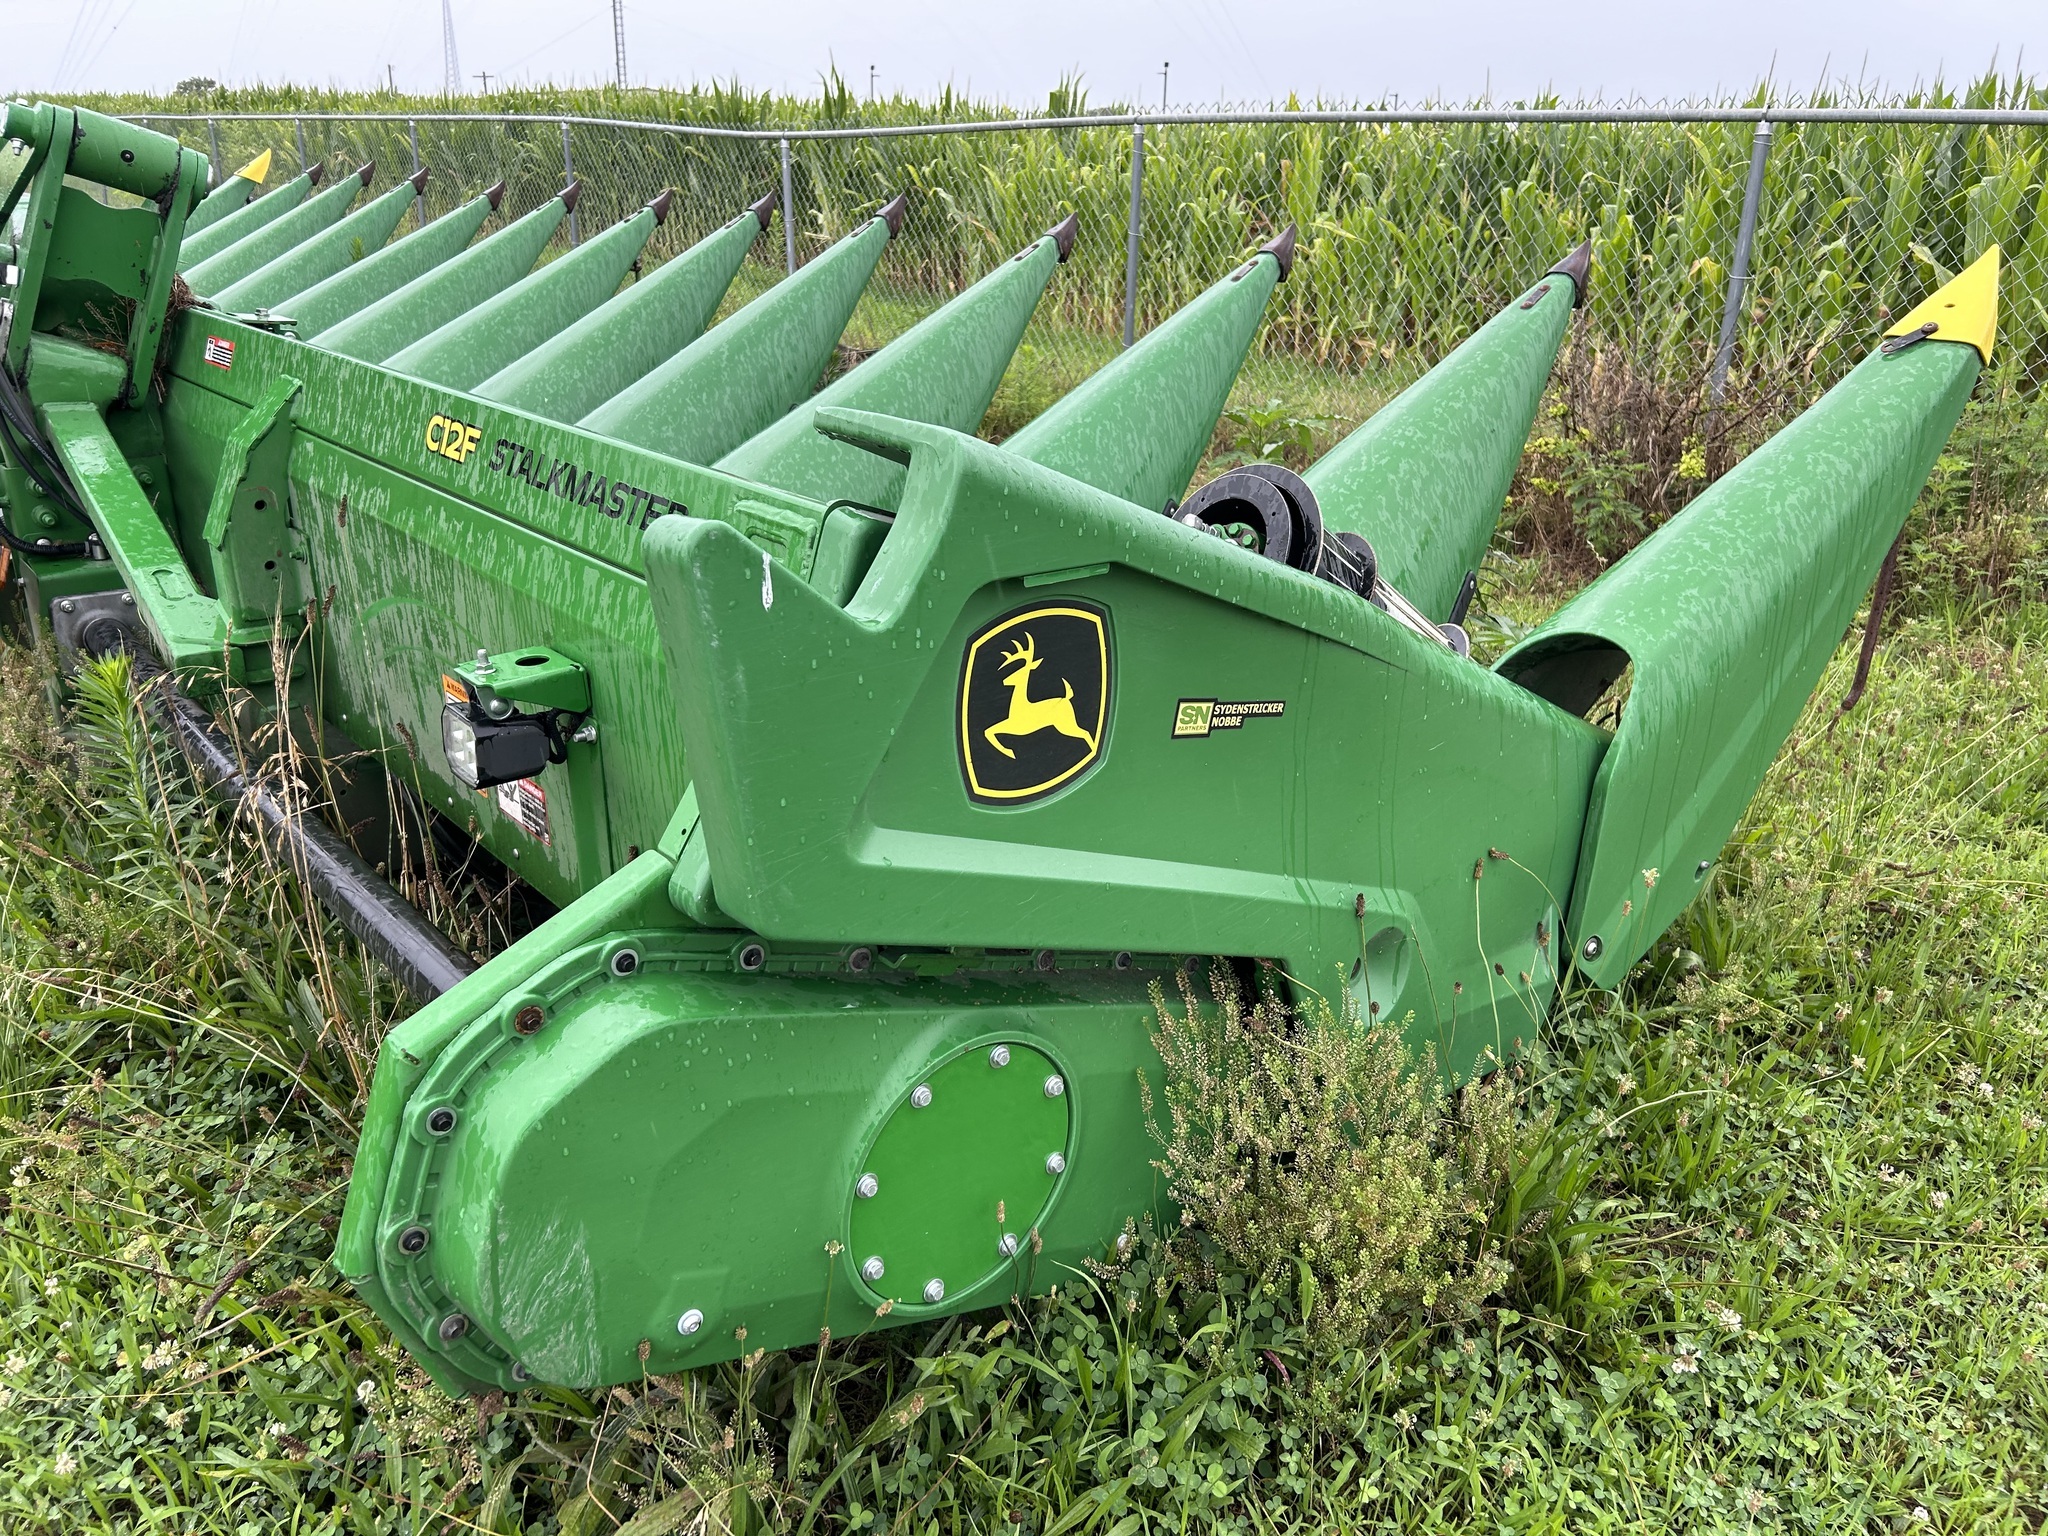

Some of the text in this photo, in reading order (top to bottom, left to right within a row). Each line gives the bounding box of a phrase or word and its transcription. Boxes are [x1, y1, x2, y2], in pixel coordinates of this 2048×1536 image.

[425, 414, 482, 463] C12F
[1179, 705, 1212, 725] SN
[1213, 703, 1284, 715] SYDENSTRICKER
[1211, 716, 1243, 728] NOBBE
